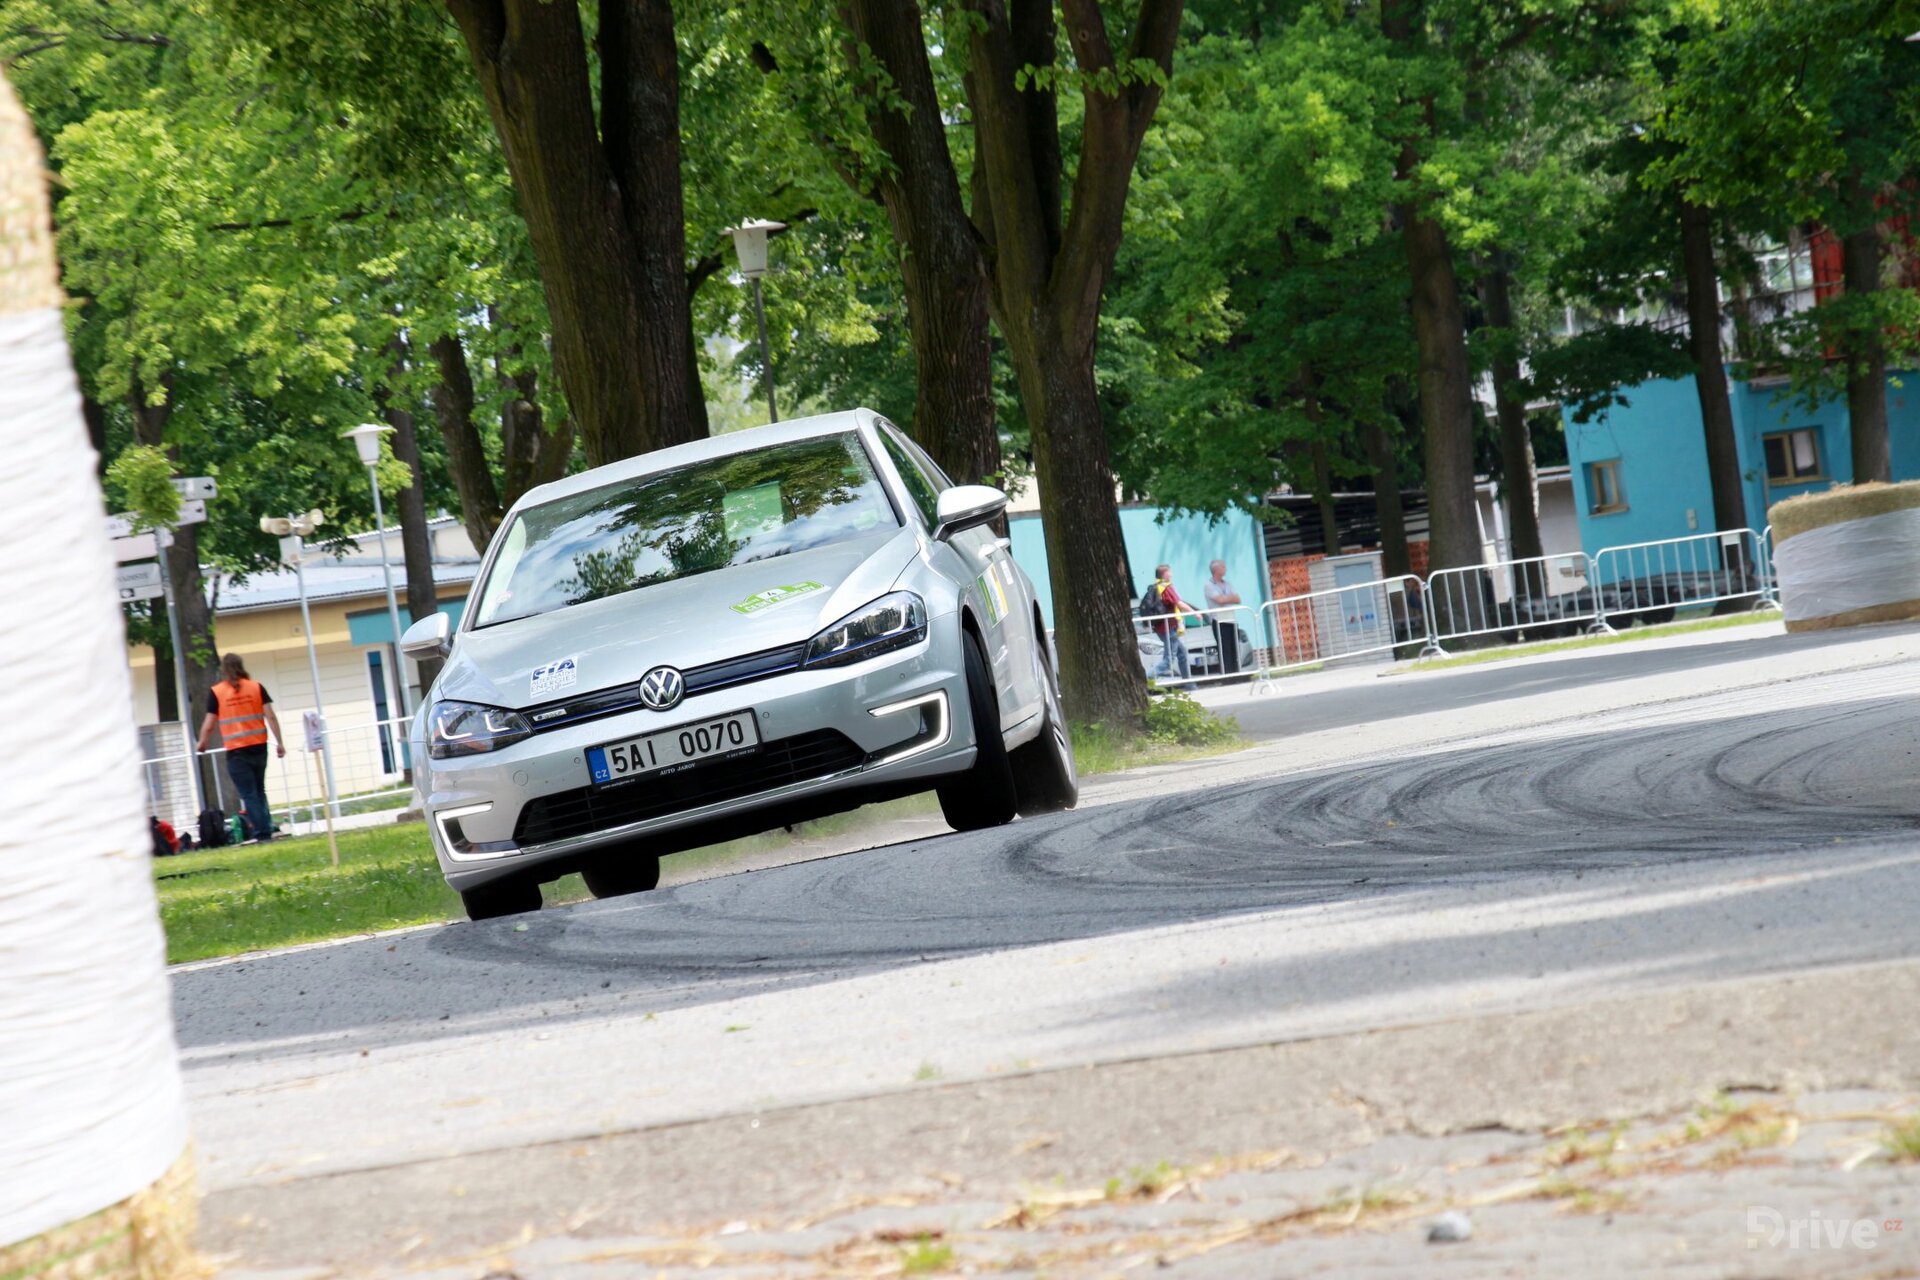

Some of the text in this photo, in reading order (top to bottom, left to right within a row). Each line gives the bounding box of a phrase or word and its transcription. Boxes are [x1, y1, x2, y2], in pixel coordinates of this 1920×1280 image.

[532, 658, 575, 681] FIA
[678, 719, 744, 757] 0070
[595, 768, 608, 779] CZ
[659, 767, 676, 776] AUTO
